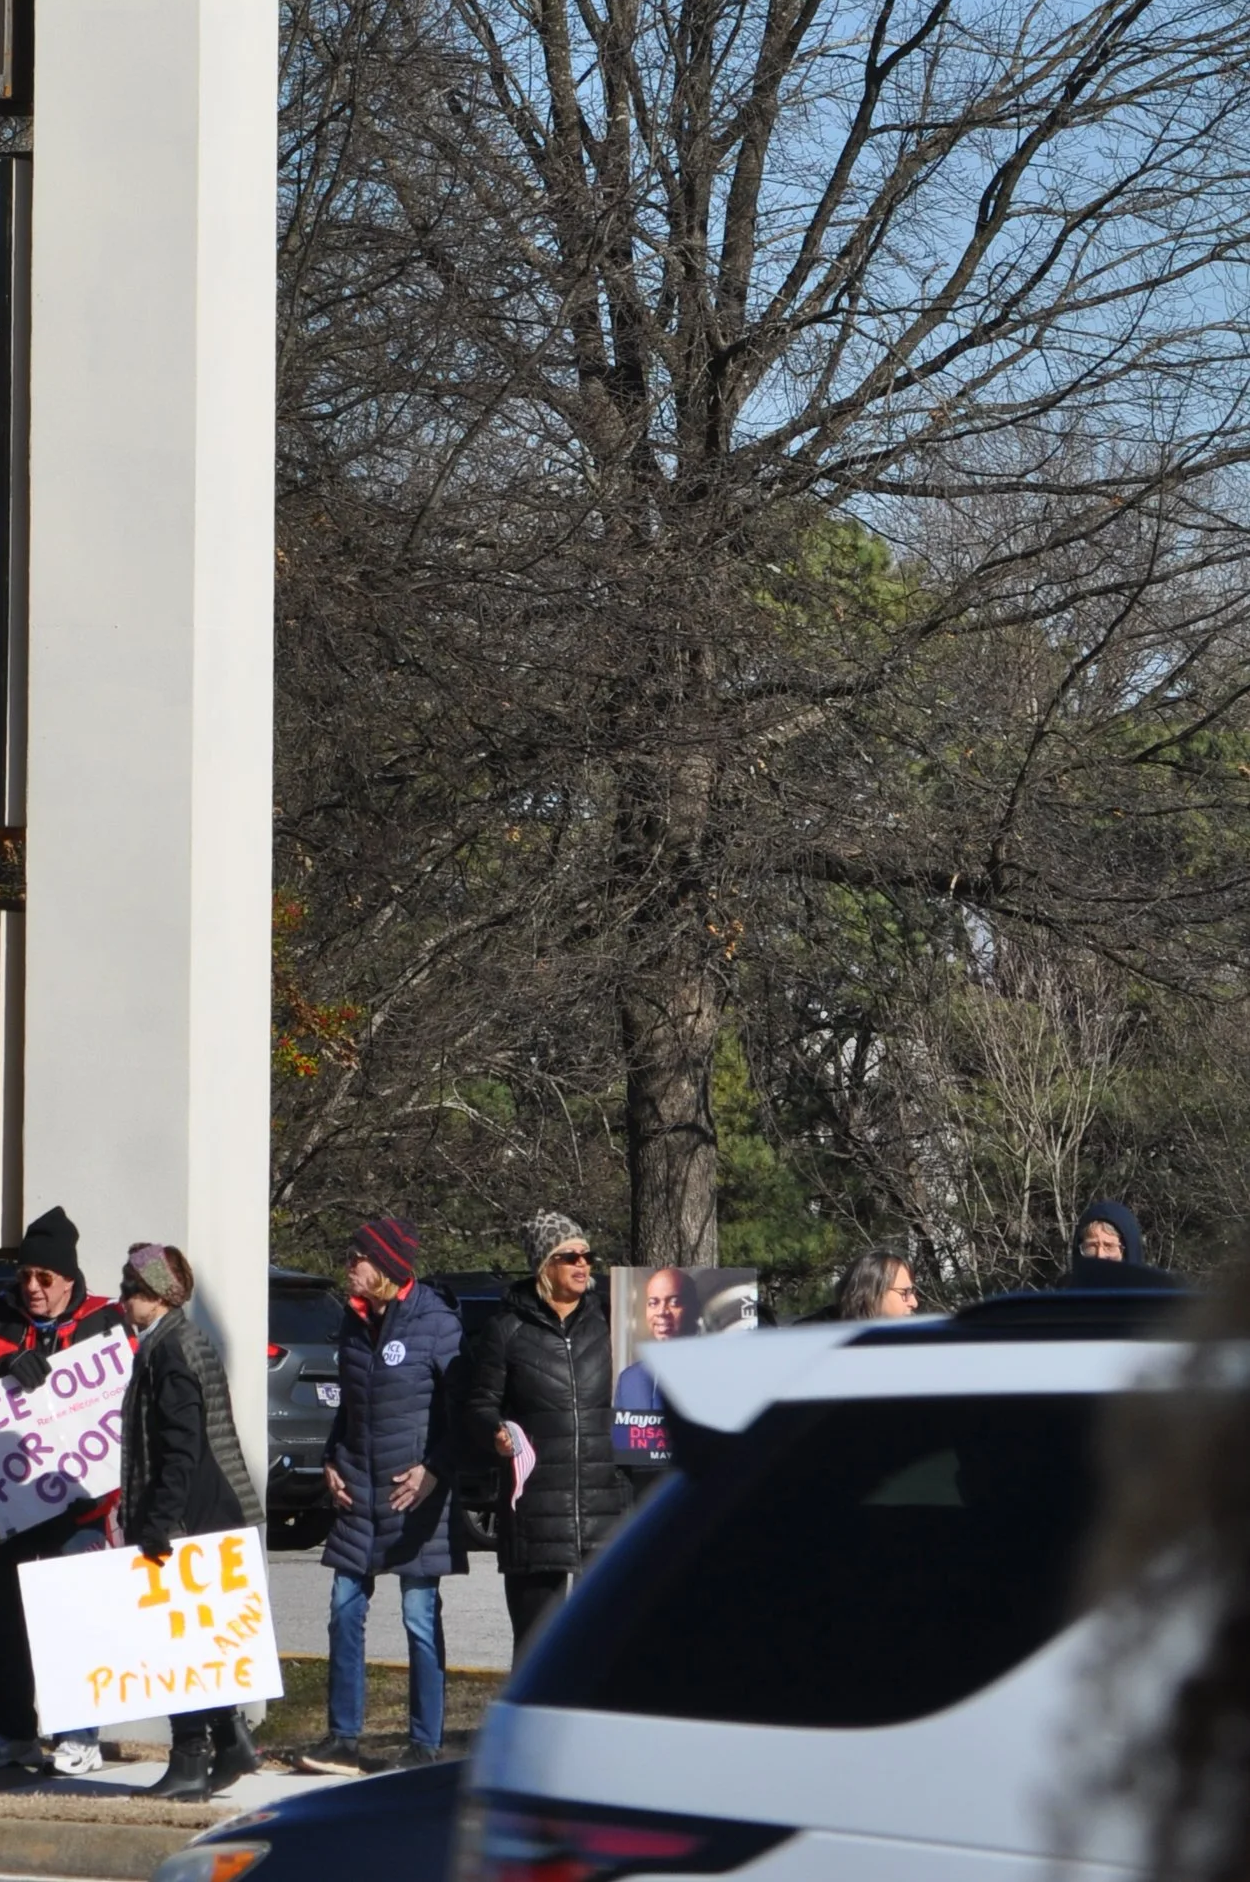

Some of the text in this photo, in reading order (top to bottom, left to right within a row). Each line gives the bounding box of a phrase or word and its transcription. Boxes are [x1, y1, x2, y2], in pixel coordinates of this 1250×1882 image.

[50, 1341, 125, 1399] OUT
[615, 1411, 665, 1428] Mayor
[35, 1409, 123, 1504] GOOD
[131, 1535, 249, 1609] ICE
